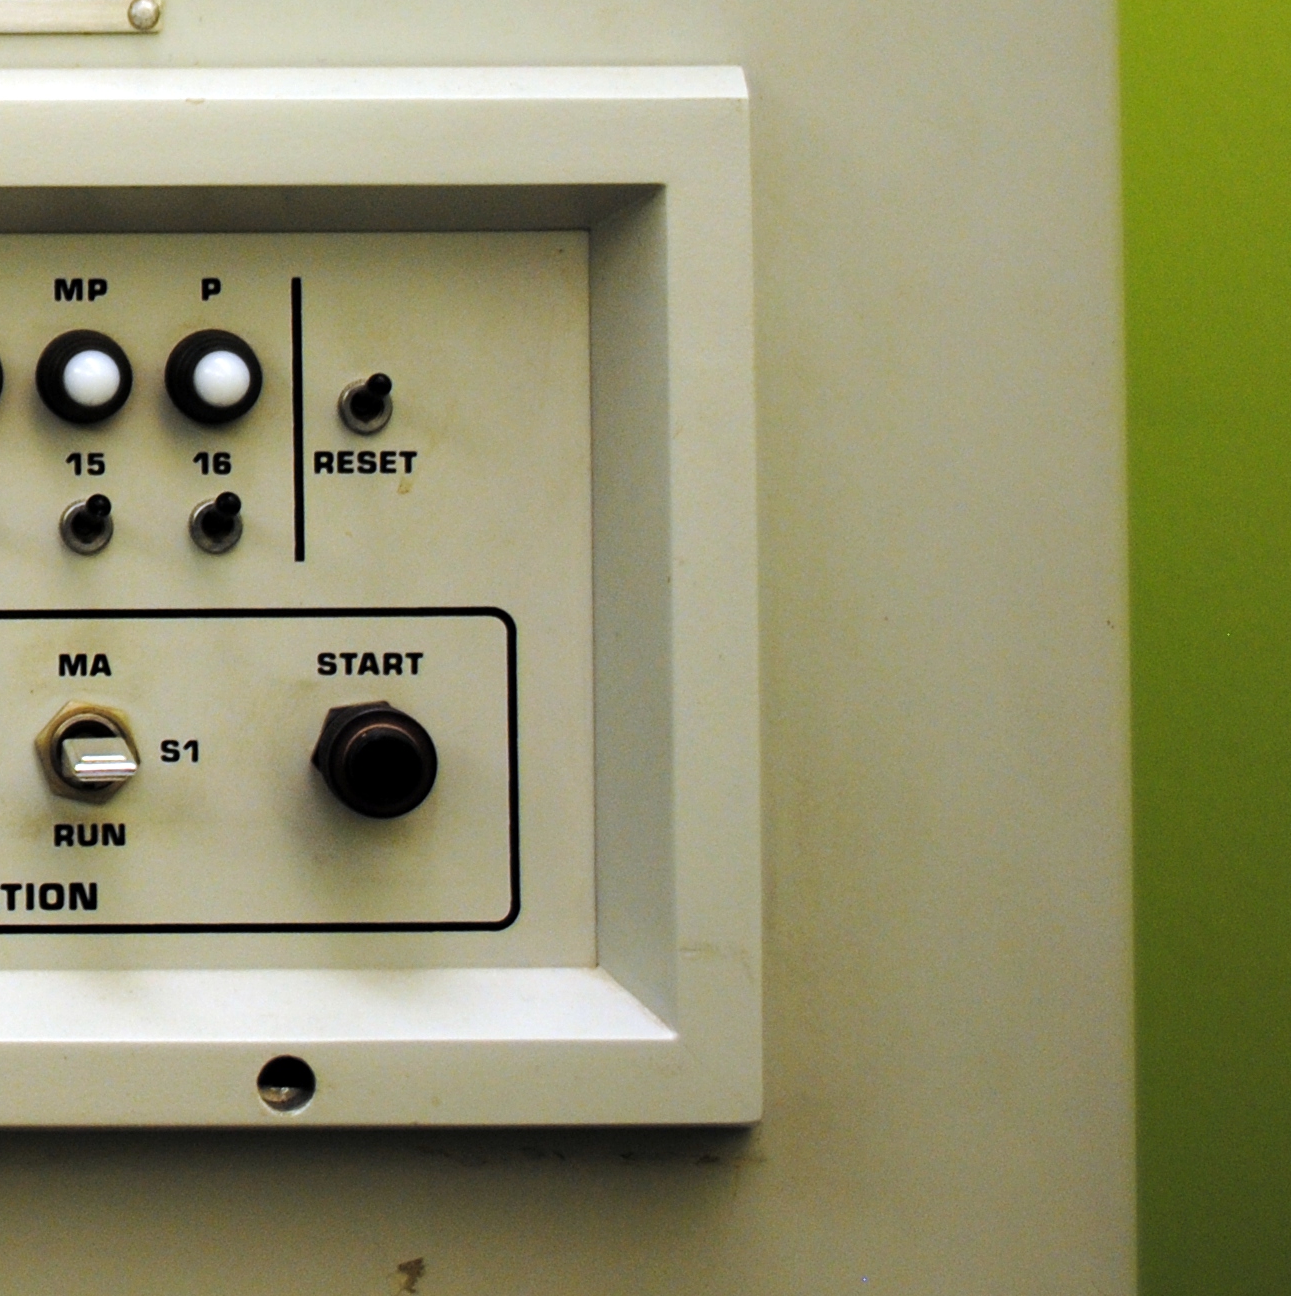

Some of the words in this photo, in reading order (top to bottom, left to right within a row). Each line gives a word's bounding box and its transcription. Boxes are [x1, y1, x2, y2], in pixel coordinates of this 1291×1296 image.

[54, 278, 108, 301] MP
[202, 277, 221, 301] P
[66, 452, 105, 476] 15
[193, 451, 231, 475] 16
[314, 450, 417, 474] RESET
[59, 654, 111, 676] MA
[318, 652, 423, 675] START
[161, 740, 198, 762] S1
[54, 823, 125, 847] RUN
